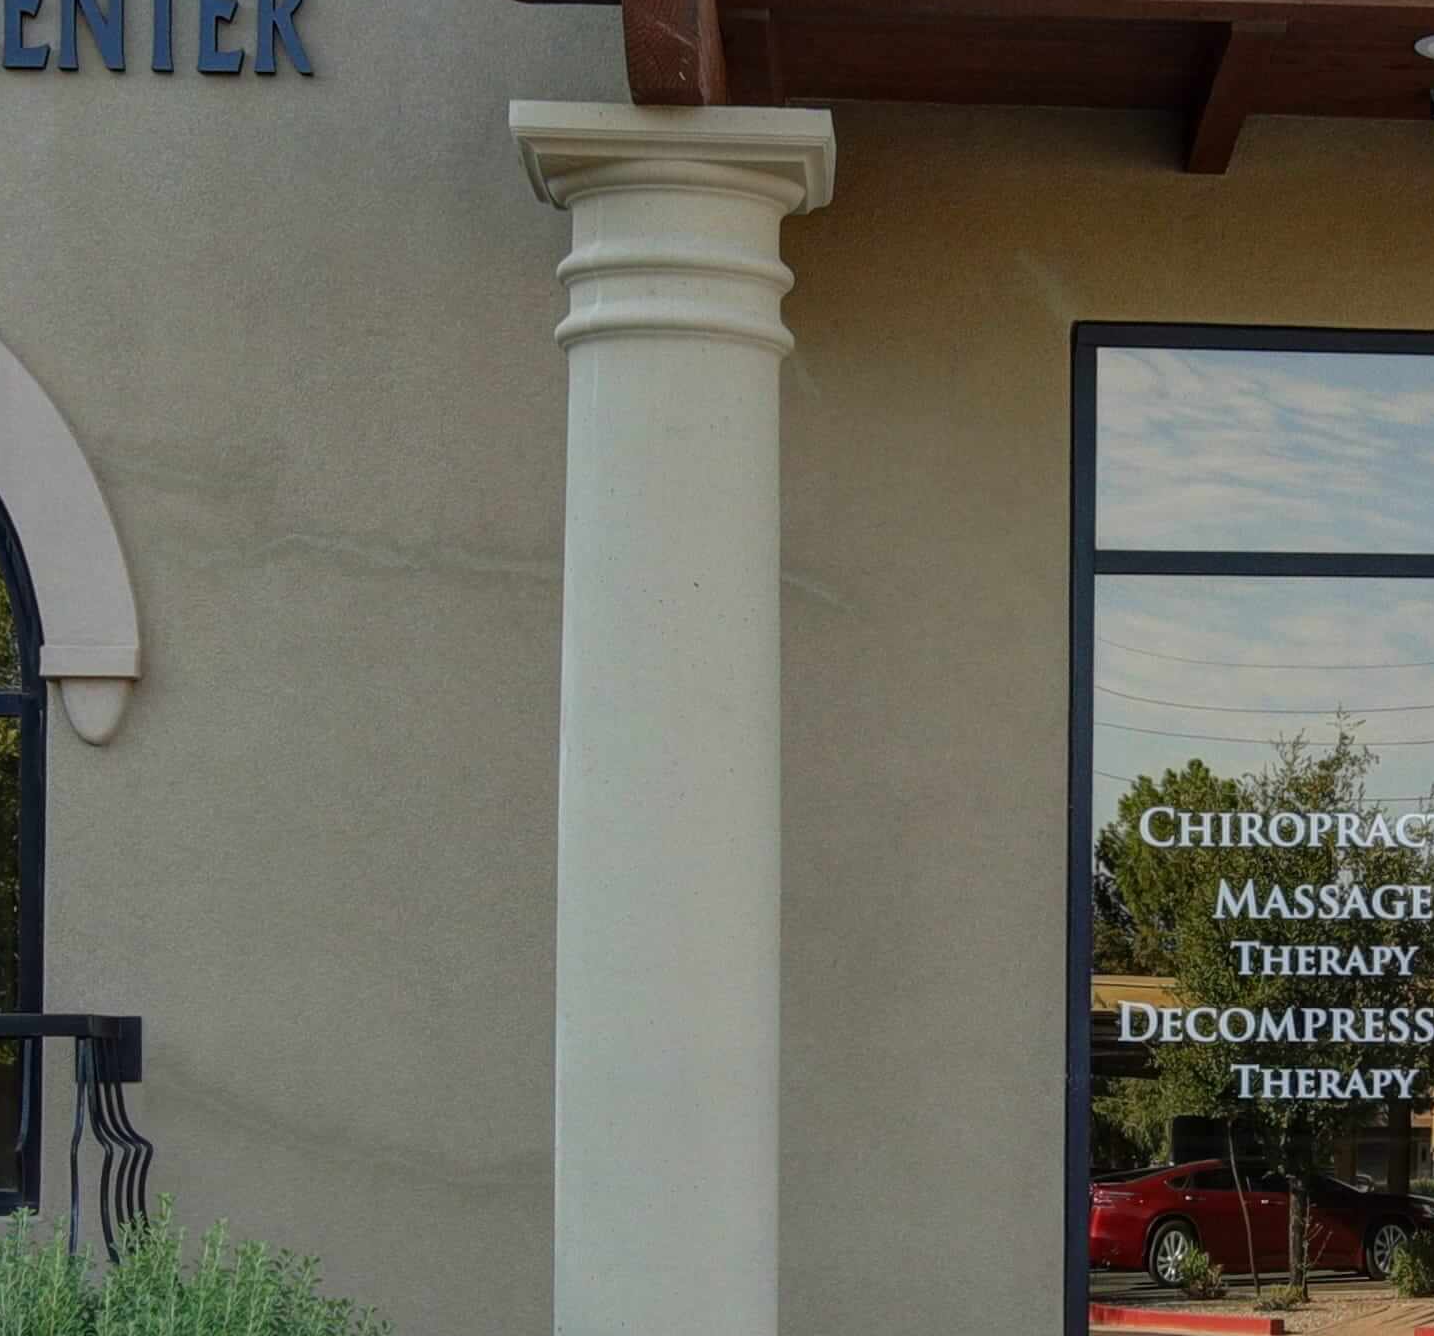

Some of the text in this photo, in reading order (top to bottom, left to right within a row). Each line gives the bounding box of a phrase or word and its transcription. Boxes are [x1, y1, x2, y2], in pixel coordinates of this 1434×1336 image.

[1212, 879, 1433, 920] MASSAGE
[1230, 940, 1420, 976] THERAPY
[1230, 1063, 1420, 1100] THERAPY
